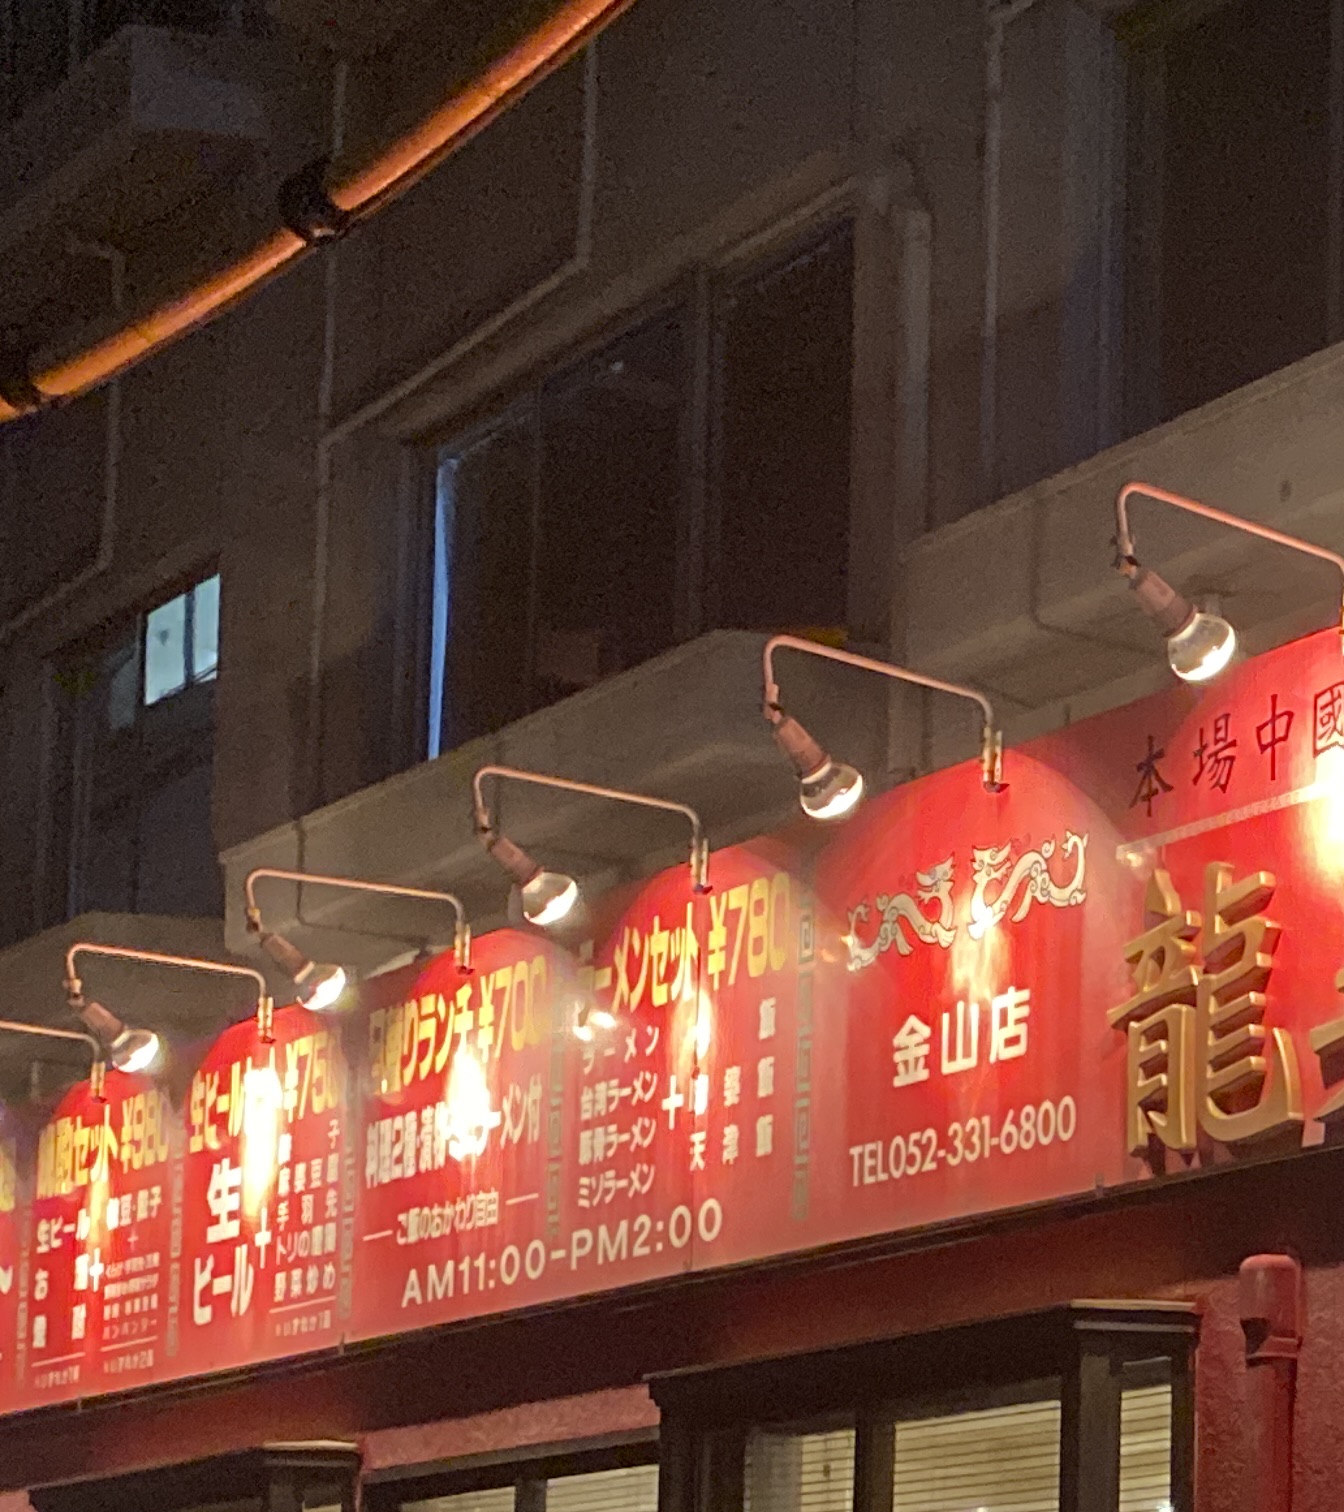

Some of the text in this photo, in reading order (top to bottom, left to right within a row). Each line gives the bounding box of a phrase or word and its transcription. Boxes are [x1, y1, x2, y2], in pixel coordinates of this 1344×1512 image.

[707, 871, 792, 992] ¥780
[891, 984, 1032, 1087] 金山店
